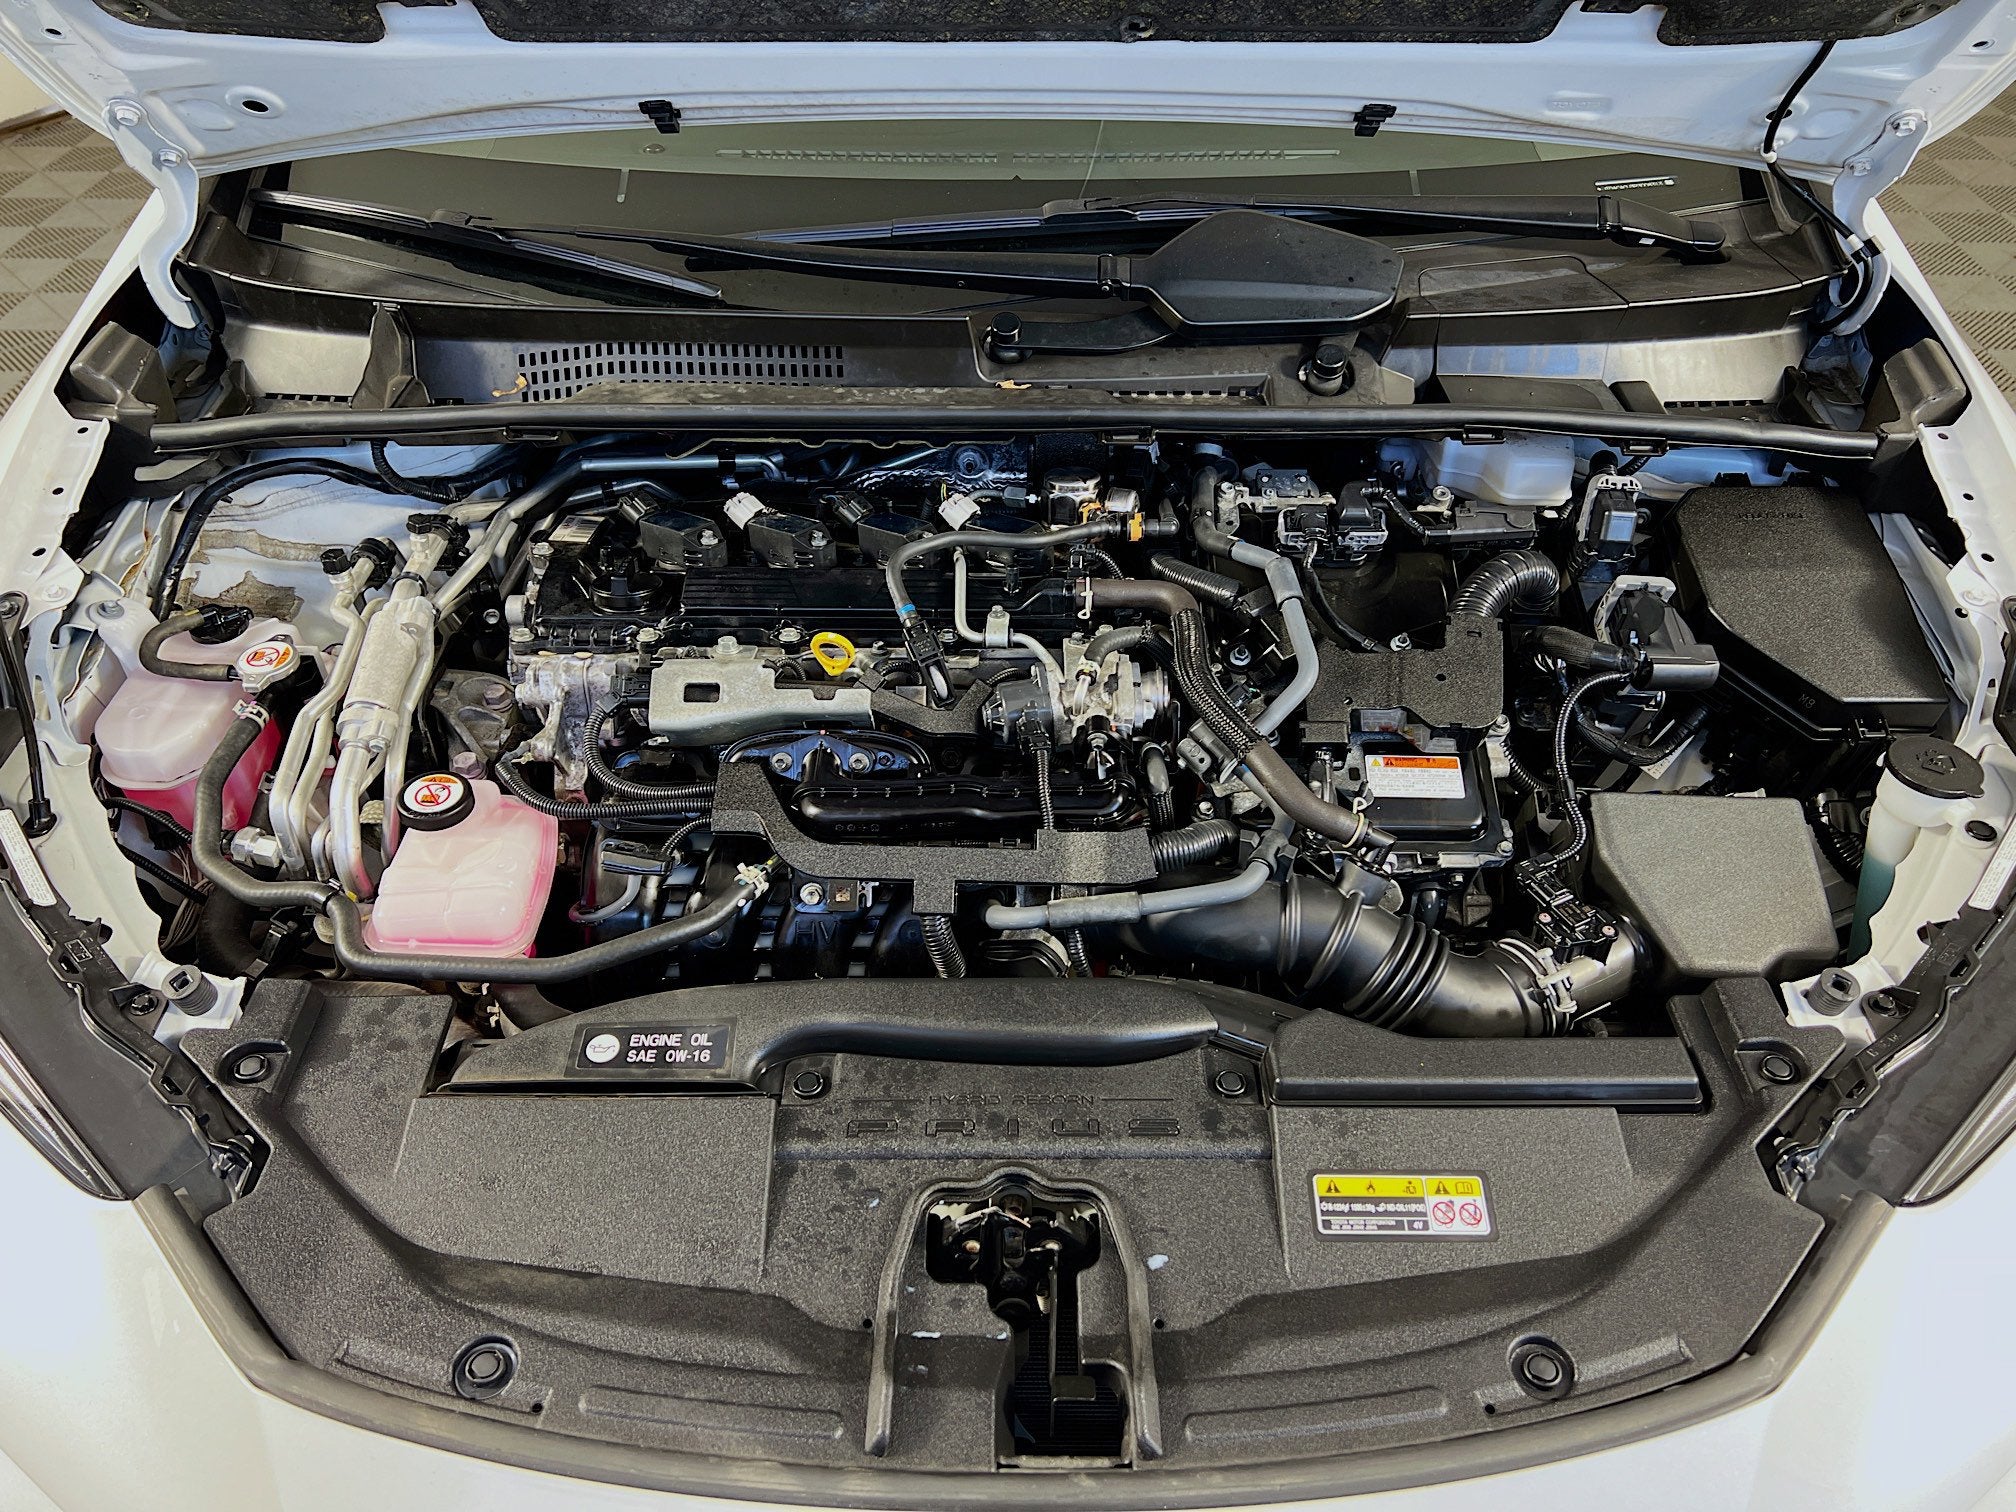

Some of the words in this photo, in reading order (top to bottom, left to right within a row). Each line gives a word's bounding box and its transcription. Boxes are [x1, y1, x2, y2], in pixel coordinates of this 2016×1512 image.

[795, 921, 838, 945] HV
[629, 1033, 683, 1047] ENGINE
[690, 1033, 713, 1047] OIL
[626, 1049, 657, 1063] SAE
[665, 1049, 711, 1063] 0W-16
[929, 1095, 1001, 1106] HYBRID
[1012, 1095, 1094, 1106] REBORN
[846, 1118, 1181, 1138] PRIUS
